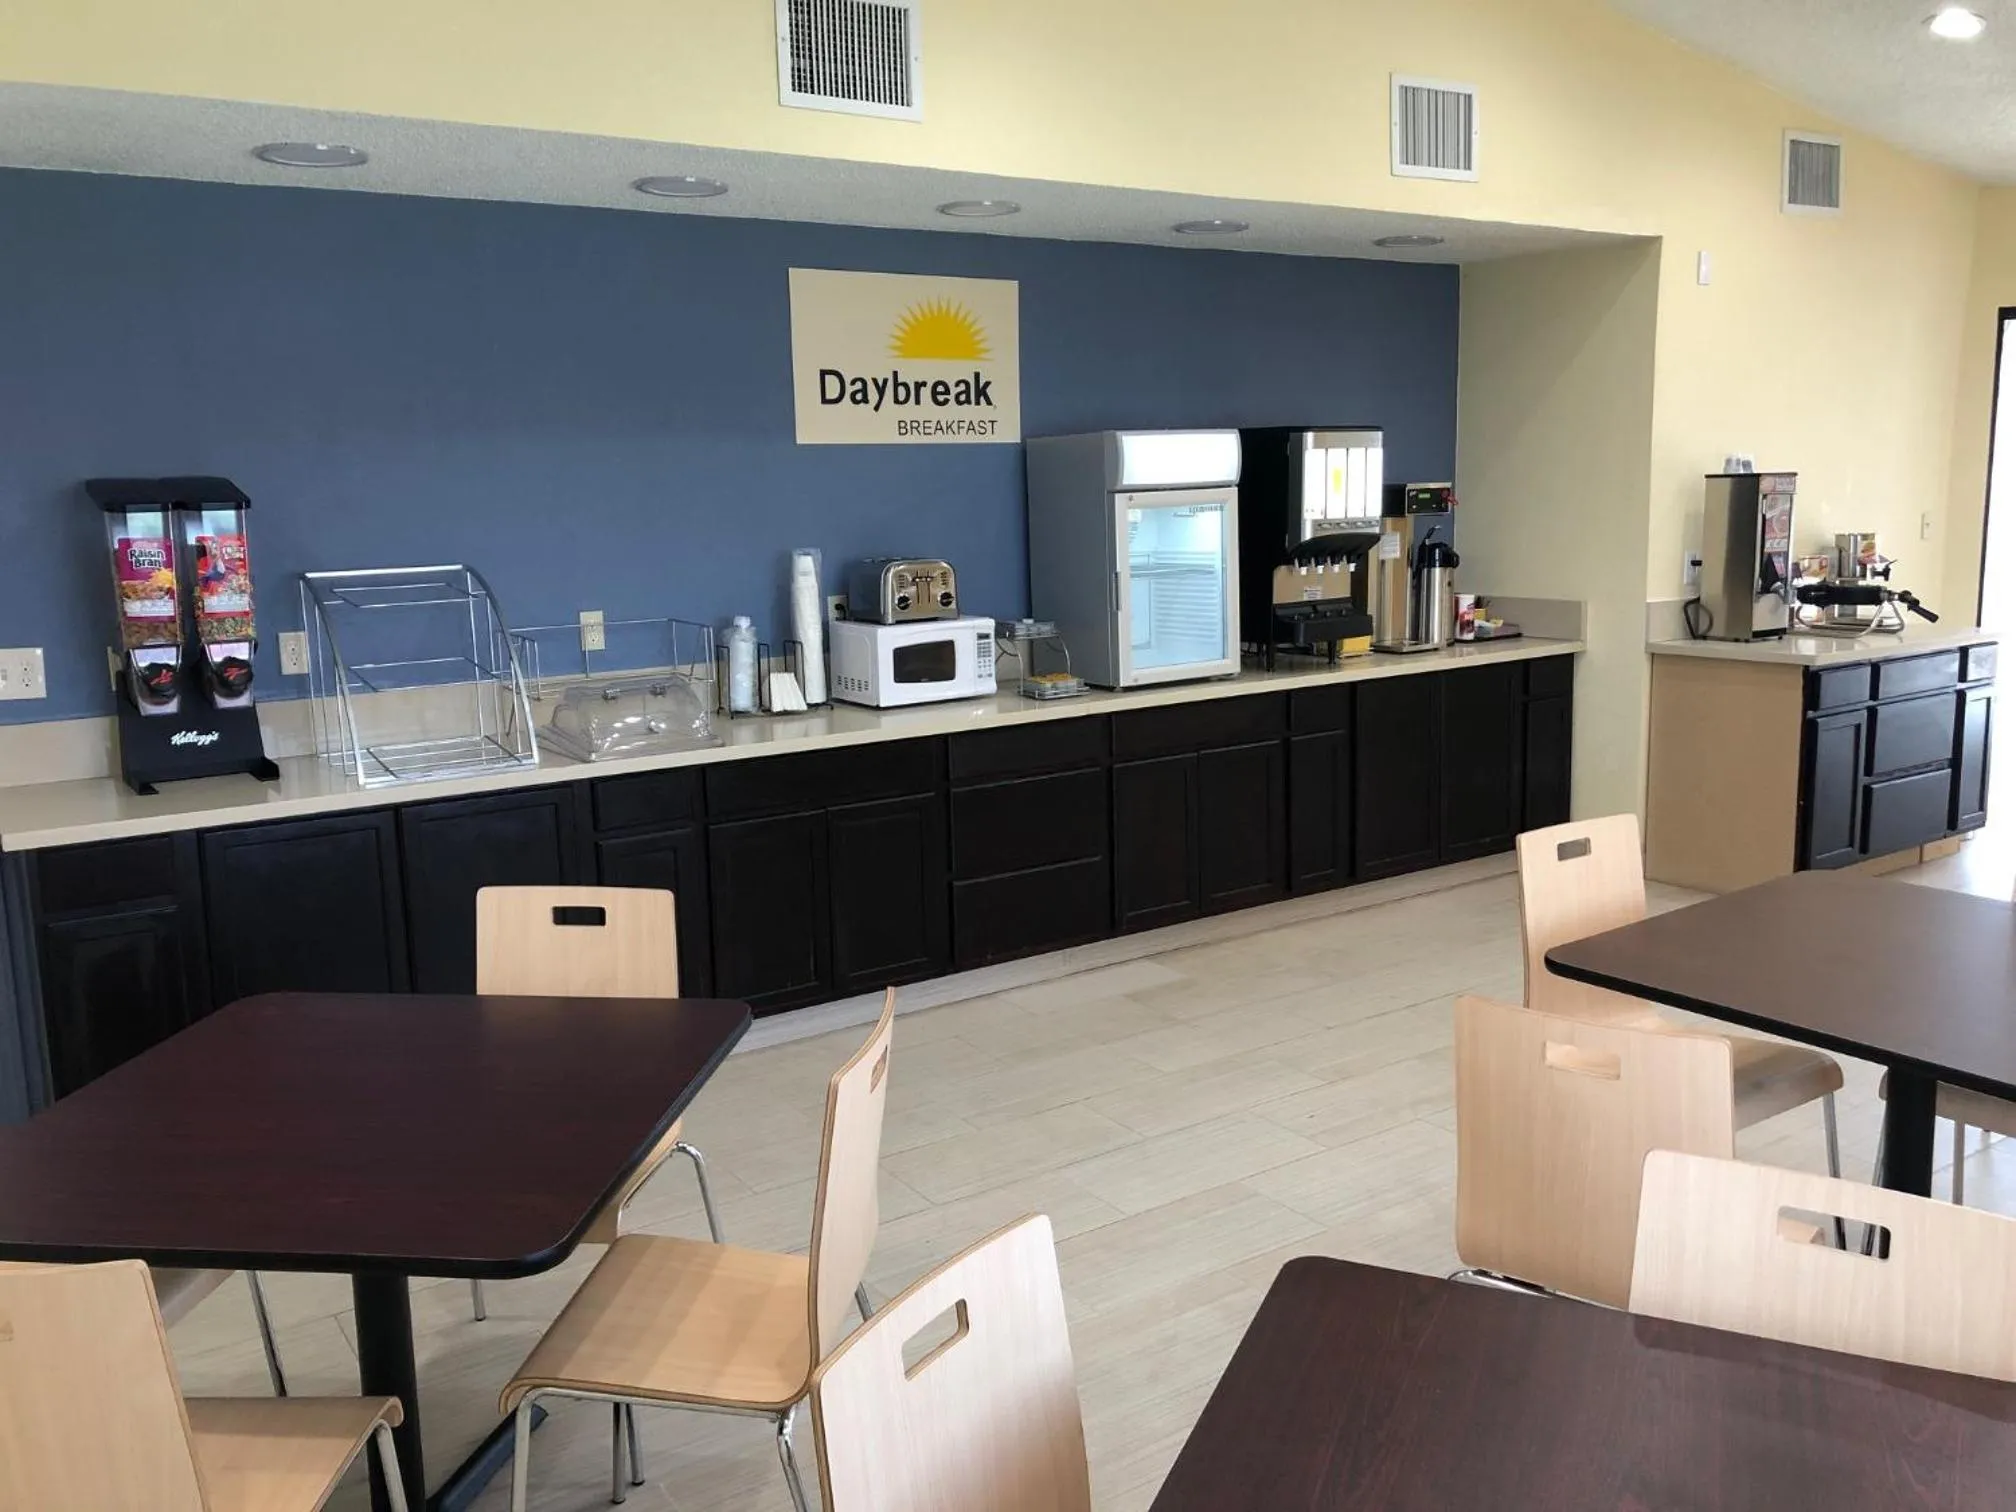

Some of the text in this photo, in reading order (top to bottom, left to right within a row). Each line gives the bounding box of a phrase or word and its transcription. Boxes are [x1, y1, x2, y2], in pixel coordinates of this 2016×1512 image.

[819, 369, 993, 412] Daybreak
[898, 420, 998, 436] BREAKFAST
[129, 549, 164, 560] Raisin
[134, 558, 162, 567] Bran
[171, 731, 220, 746] Kellogg's
